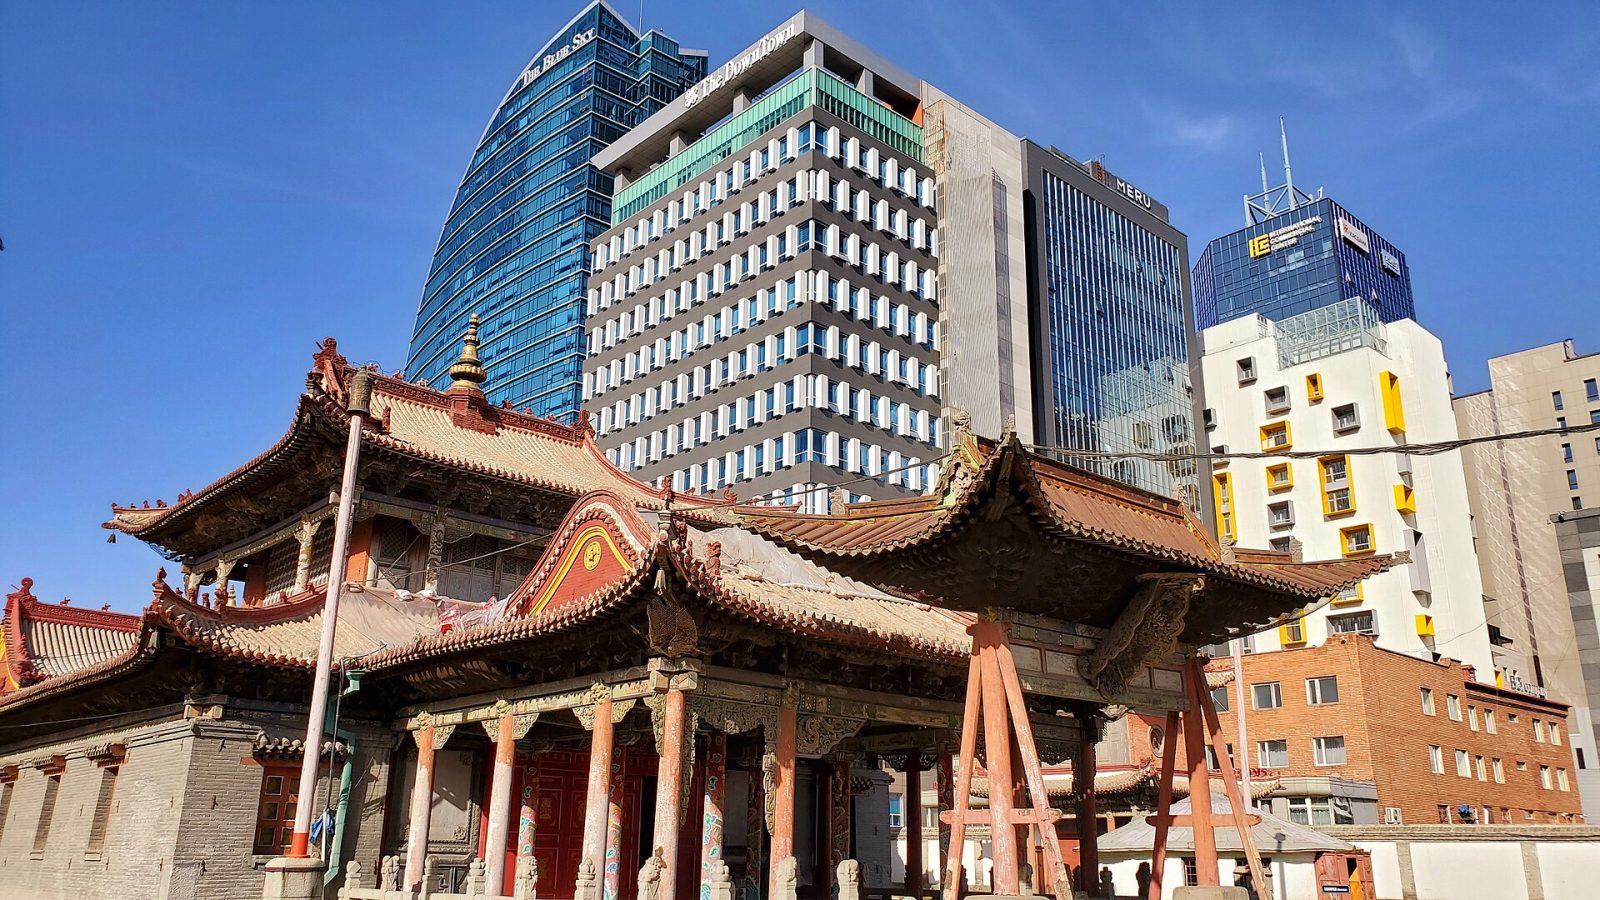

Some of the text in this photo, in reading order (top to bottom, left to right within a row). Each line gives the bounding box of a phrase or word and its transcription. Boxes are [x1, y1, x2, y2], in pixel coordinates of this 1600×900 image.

[572, 27, 596, 51] SKY
[701, 74, 724, 98] The
[1116, 177, 1151, 208] MERU
[1269, 215, 1323, 240] INTERNATIONAL
[1270, 237, 1298, 252] CENTER
